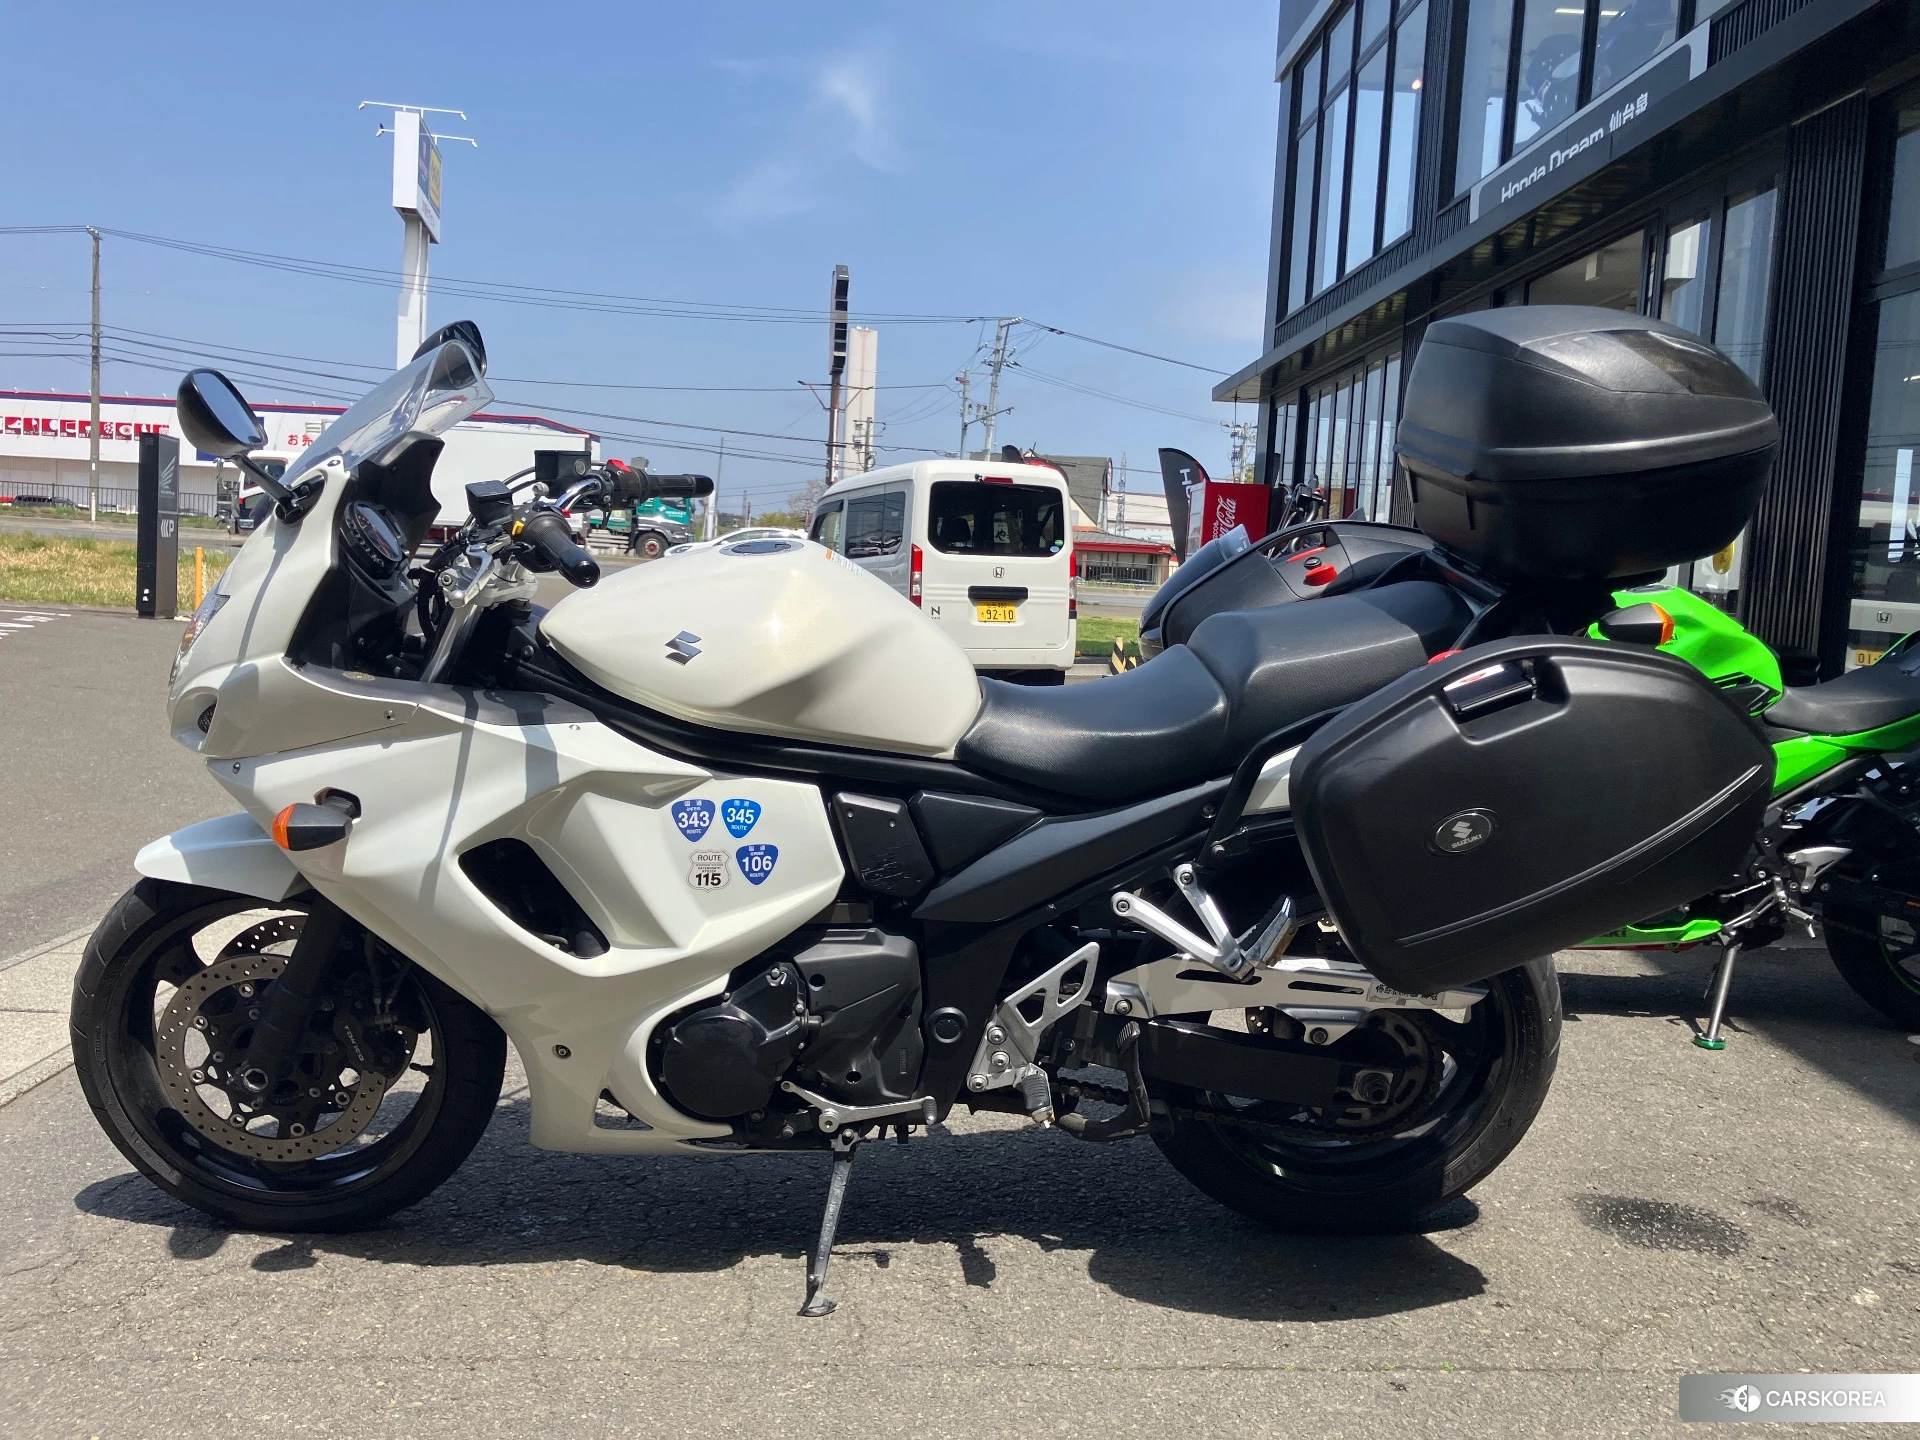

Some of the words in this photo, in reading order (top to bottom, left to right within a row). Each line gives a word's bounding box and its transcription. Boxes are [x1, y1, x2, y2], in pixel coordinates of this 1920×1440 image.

[1501, 165, 1546, 203] Honda
[1549, 127, 1604, 172] Dream
[930, 605, 941, 616] N
[986, 609, 1014, 620] 92-10
[678, 811, 710, 828] 343
[726, 807, 754, 824] 345
[1451, 833, 1483, 849] SUZUKI
[742, 855, 772, 872] 106
[695, 872, 722, 886] 115
[344, 1025, 365, 1062] TOKICO
